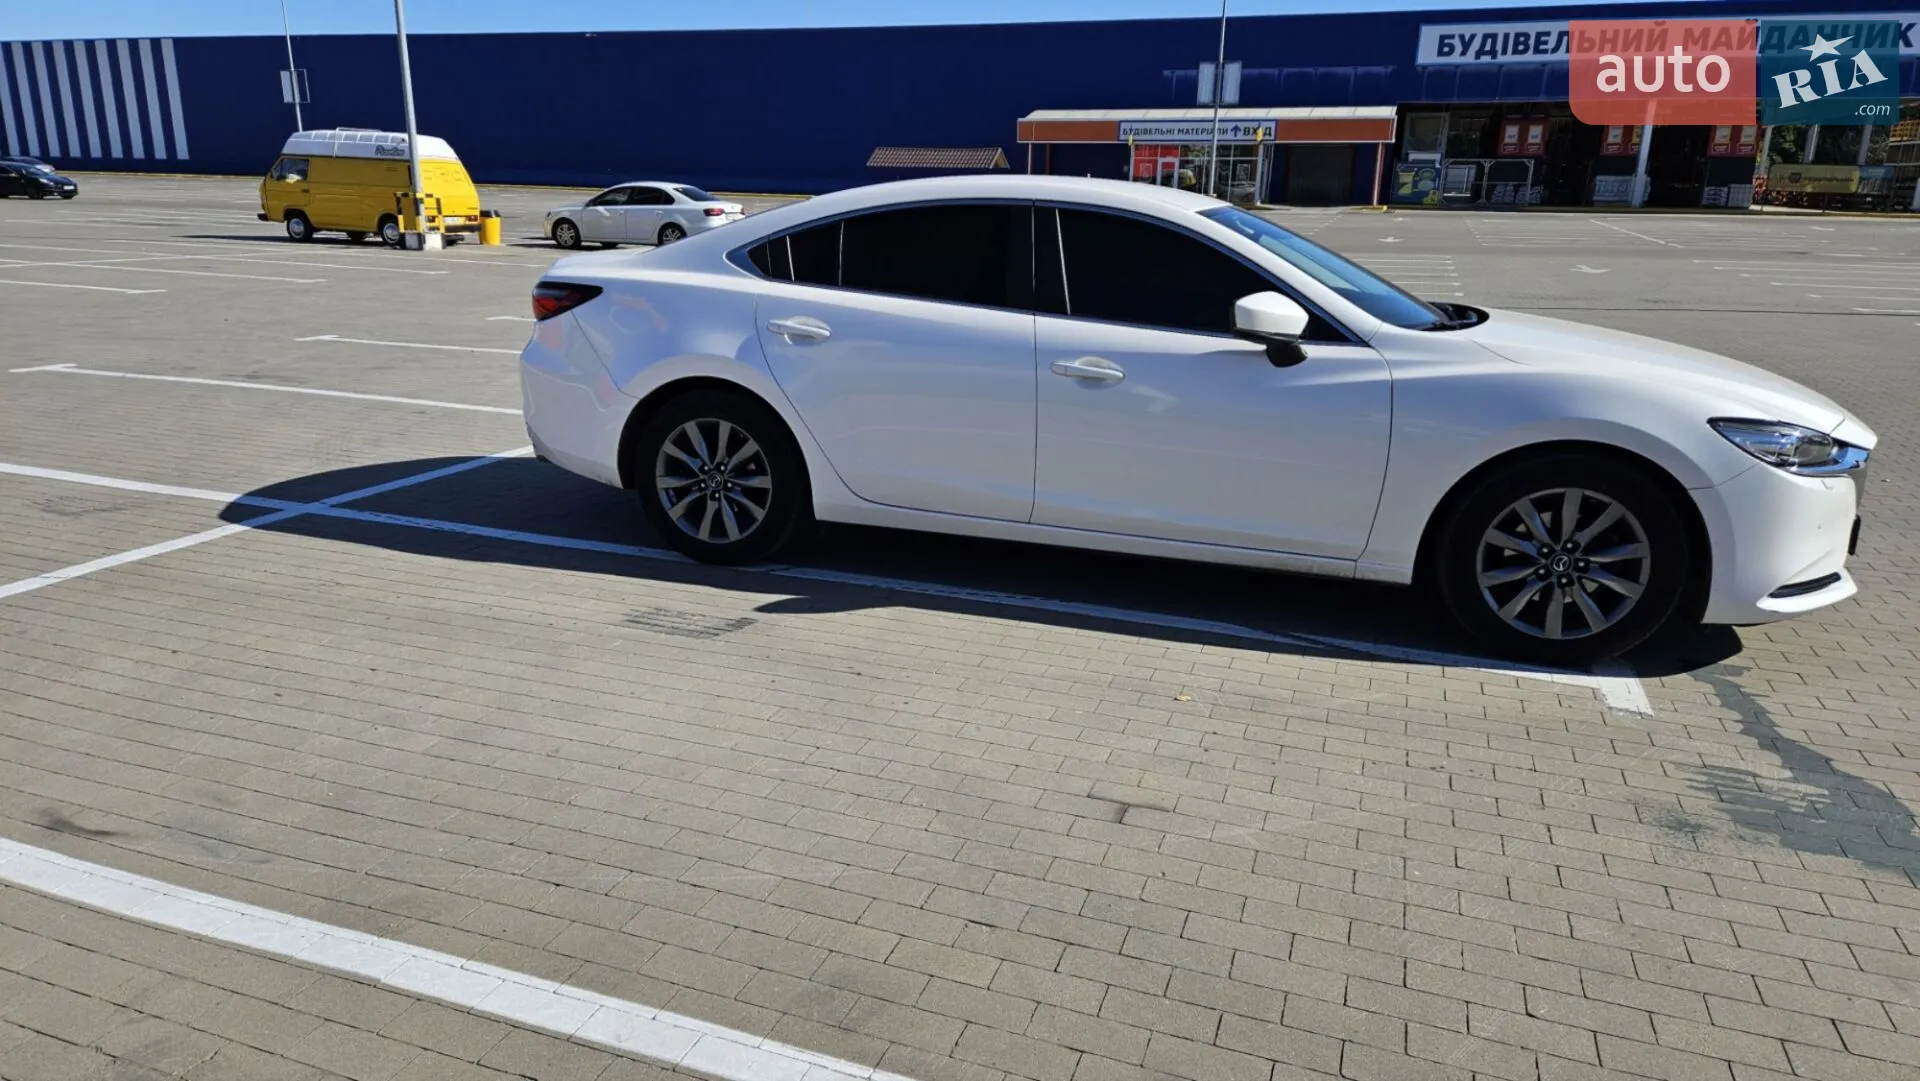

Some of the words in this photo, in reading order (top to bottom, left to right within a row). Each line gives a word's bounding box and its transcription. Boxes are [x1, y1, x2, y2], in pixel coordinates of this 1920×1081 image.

[1436, 20, 1669, 60] БУДІВЕЛЬНИЙ
[1122, 127, 1175, 137] БУДІВЕЛЬНІ
[1242, 126, 1273, 137] ВХД
